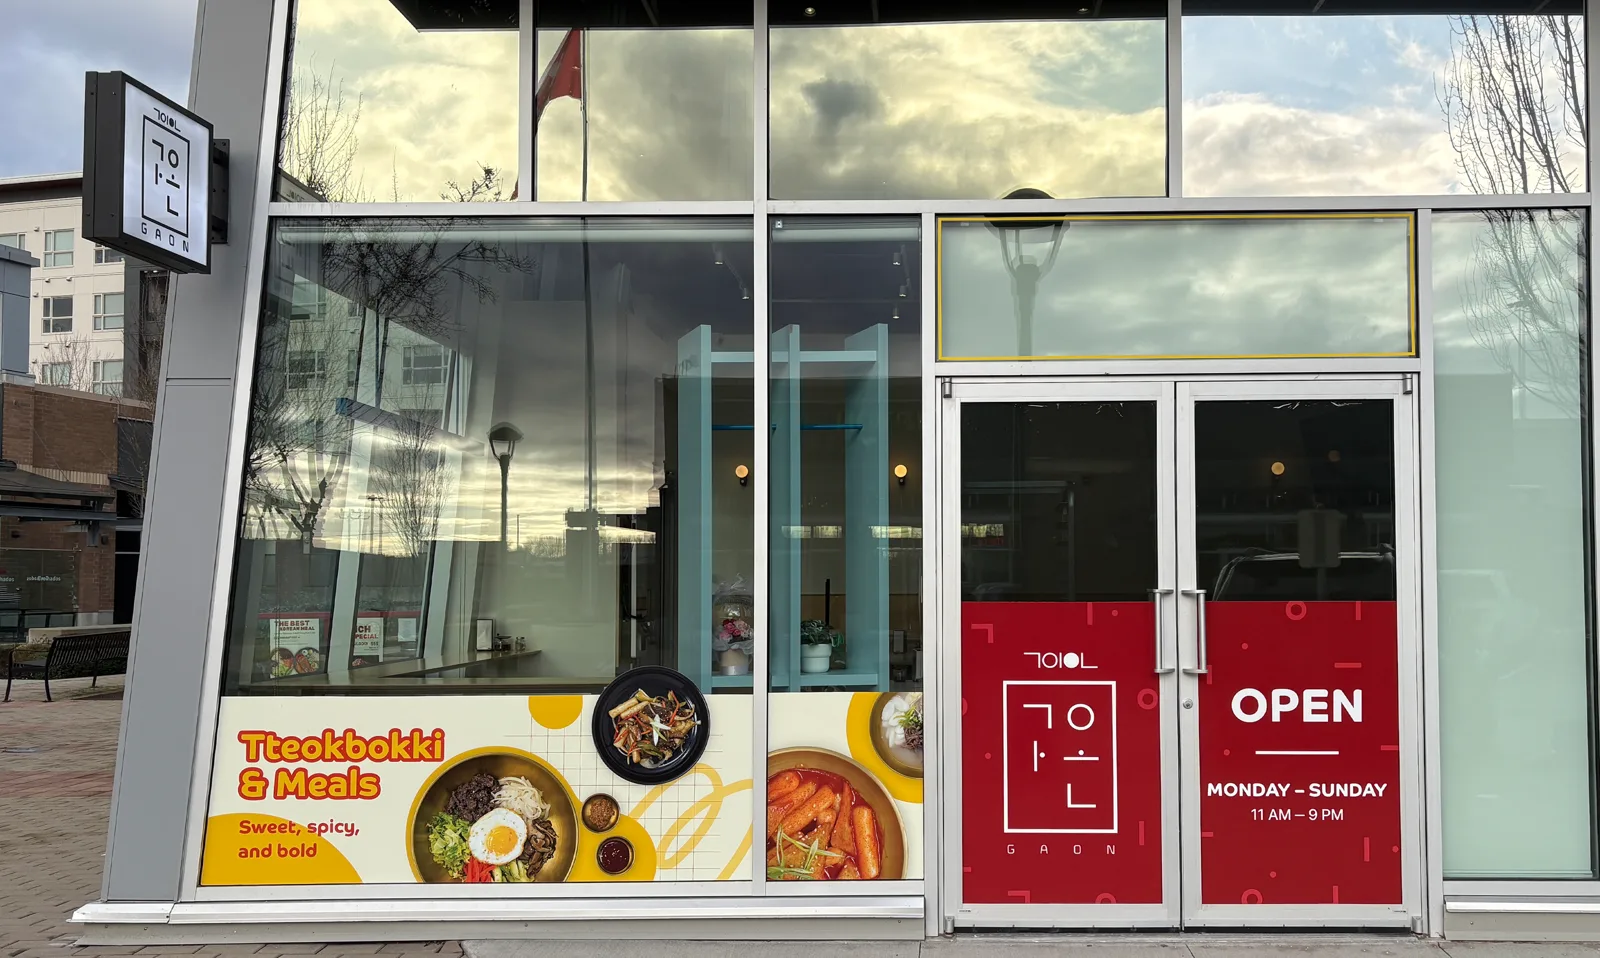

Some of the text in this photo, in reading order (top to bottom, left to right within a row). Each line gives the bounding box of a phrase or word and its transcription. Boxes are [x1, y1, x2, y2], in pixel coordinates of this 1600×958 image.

[141, 222, 189, 253] GAON
[1231, 687, 1363, 723] OPEN
[237, 728, 445, 763] Tteokbokki
[238, 765, 381, 800] & Meals
[1207, 783, 1291, 797] MONDAY
[1309, 783, 1388, 798] SUNDAY
[1251, 809, 1264, 821] 11
[1268, 809, 1291, 821] AM
[1308, 809, 1318, 821] 9
[1321, 809, 1344, 821] PM
[239, 819, 360, 837] Sweet, spicy,
[238, 843, 318, 858] and bold
[1007, 844, 1116, 855] GAON
